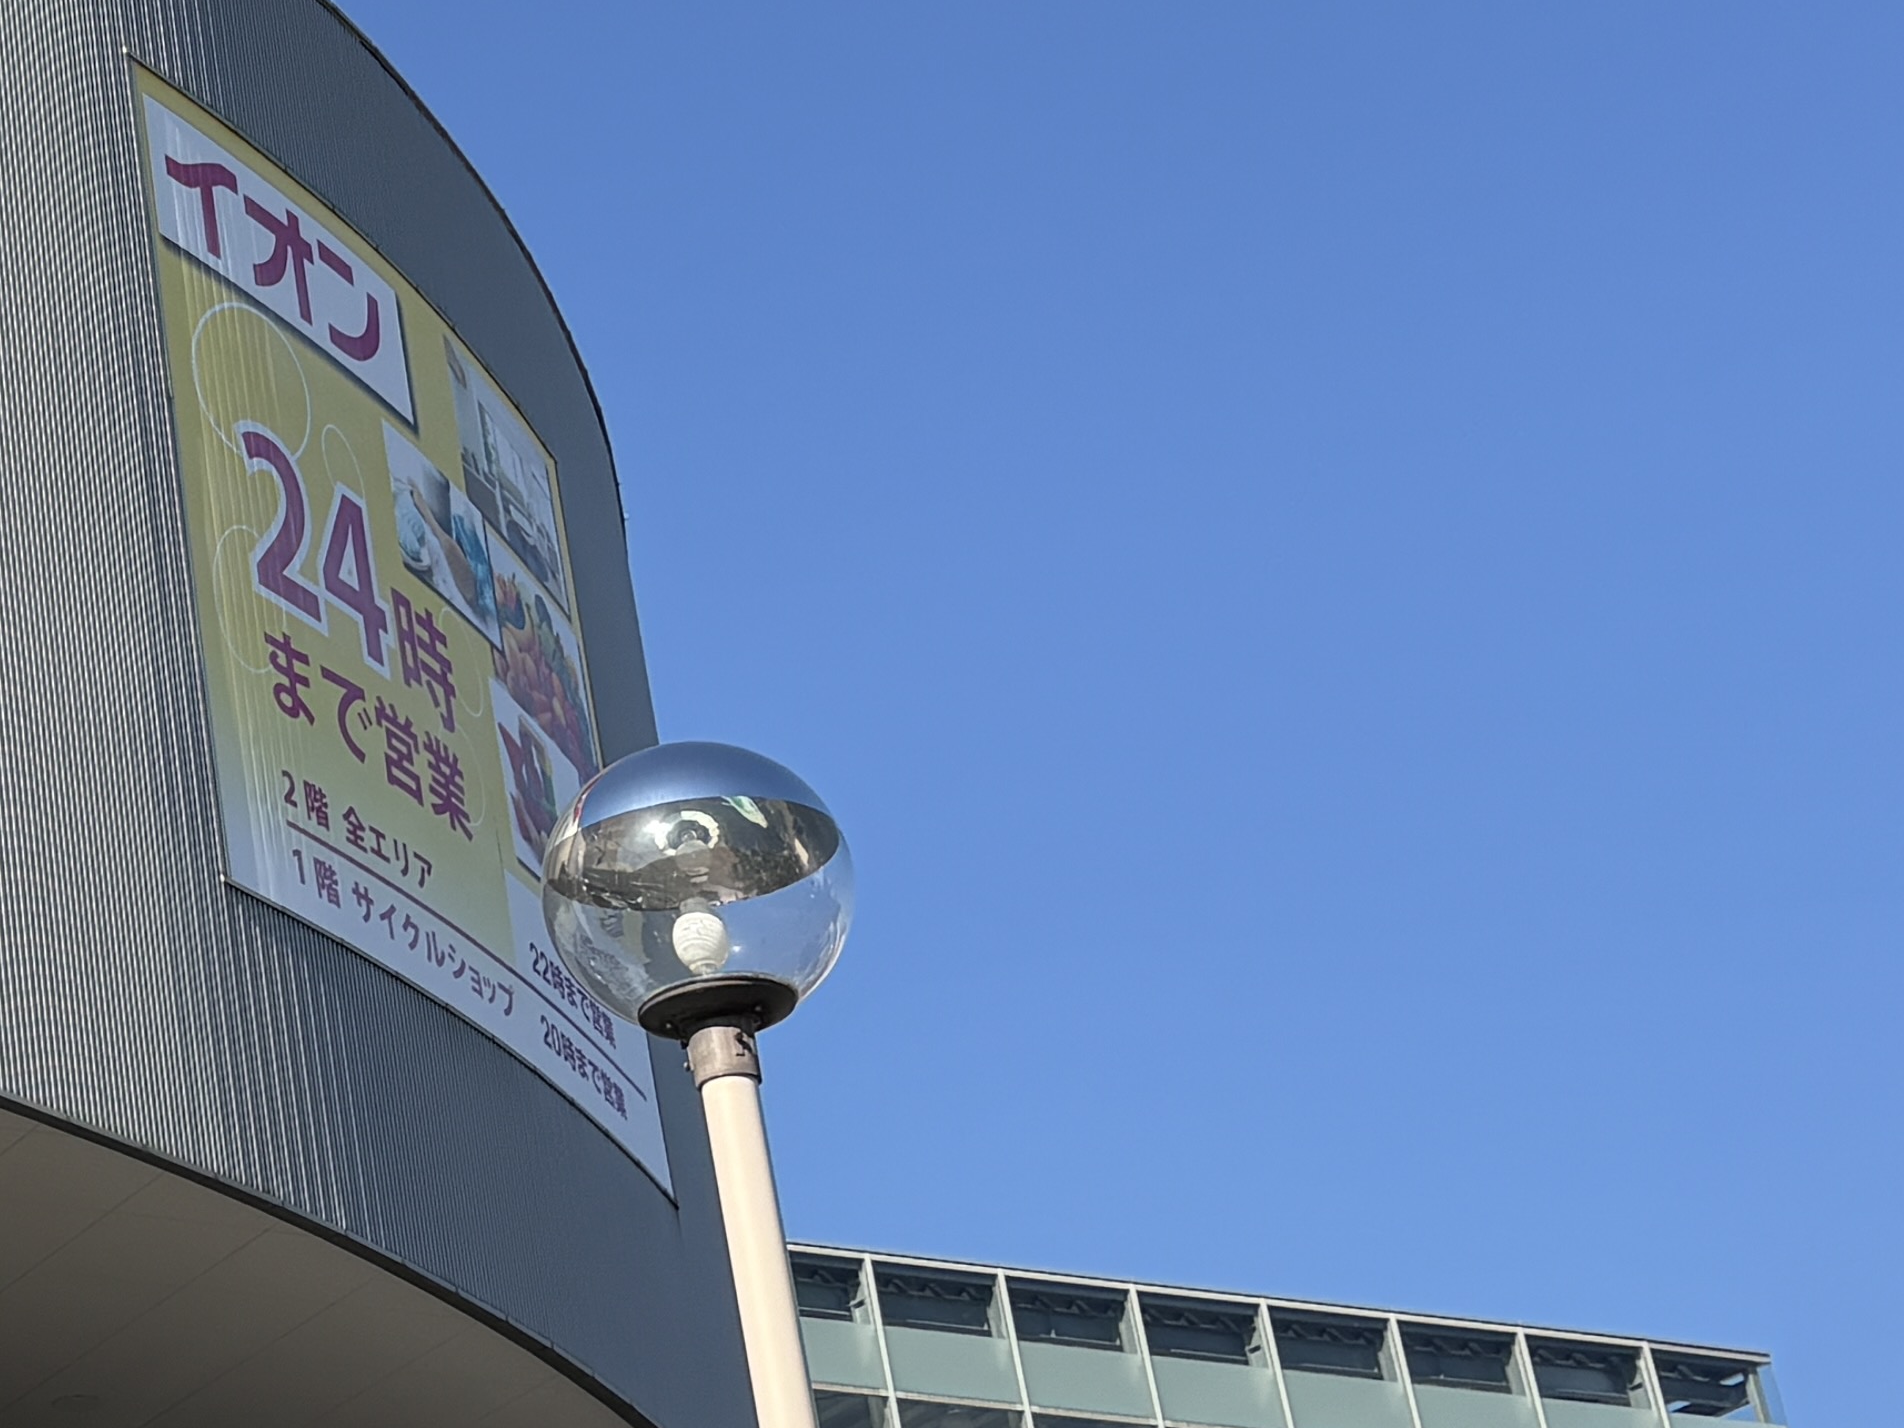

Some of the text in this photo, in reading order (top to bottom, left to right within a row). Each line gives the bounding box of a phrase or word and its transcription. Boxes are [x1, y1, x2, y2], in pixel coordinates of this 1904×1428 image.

[164, 154, 380, 362] イオン
[240, 429, 457, 733] 24時
[263, 631, 473, 842] まで営業
[281, 769, 330, 832] 2階
[342, 805, 433, 888] 全エリア
[293, 848, 628, 1121] 1階 サイクルショップ 20時まで営業
